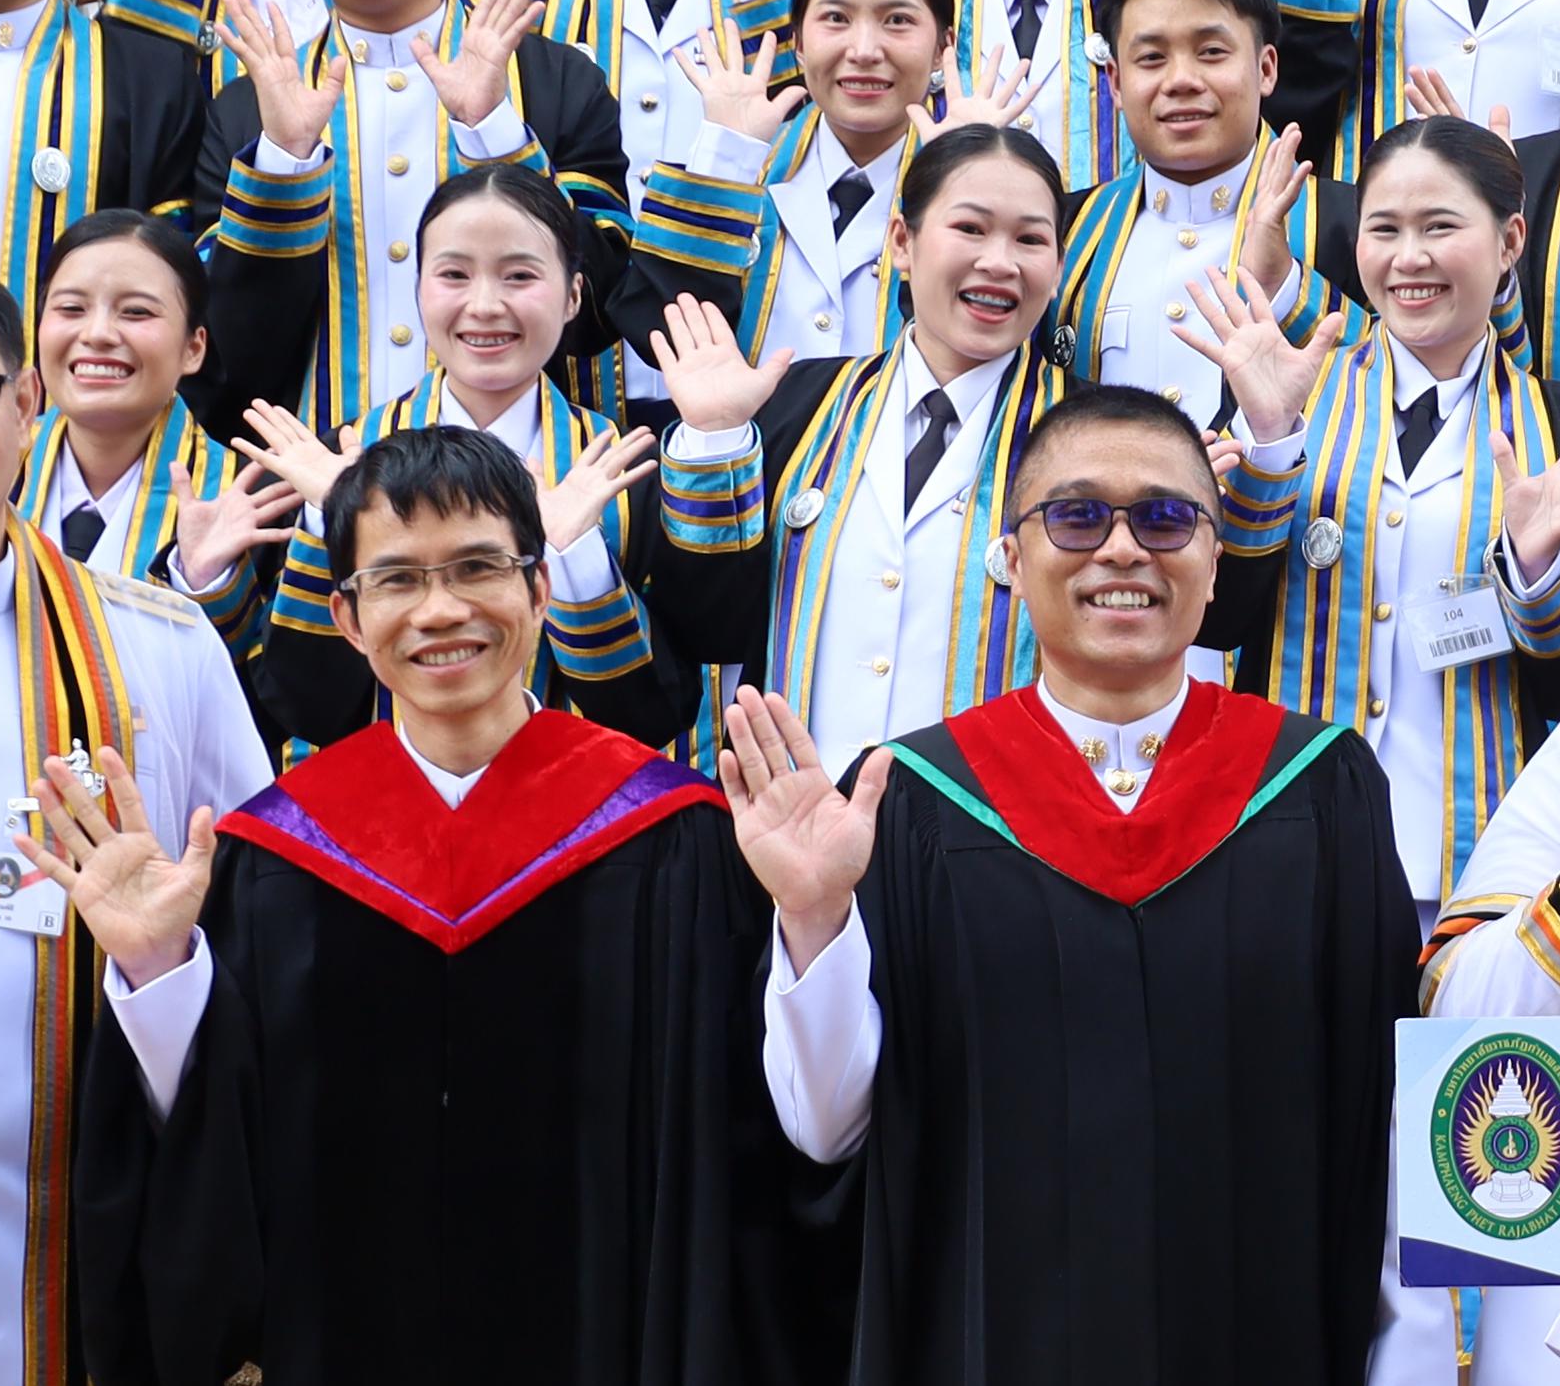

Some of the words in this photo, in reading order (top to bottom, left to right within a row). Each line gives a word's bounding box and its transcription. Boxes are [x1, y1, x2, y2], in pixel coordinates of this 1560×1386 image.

[1443, 608, 1464, 622] 104
[43, 915, 54, 928] B
[1435, 1134, 1469, 1209] KAMPHAENG
[1468, 1207, 1495, 1233] PHET
[1498, 1207, 1559, 1238] RAJABHAT
